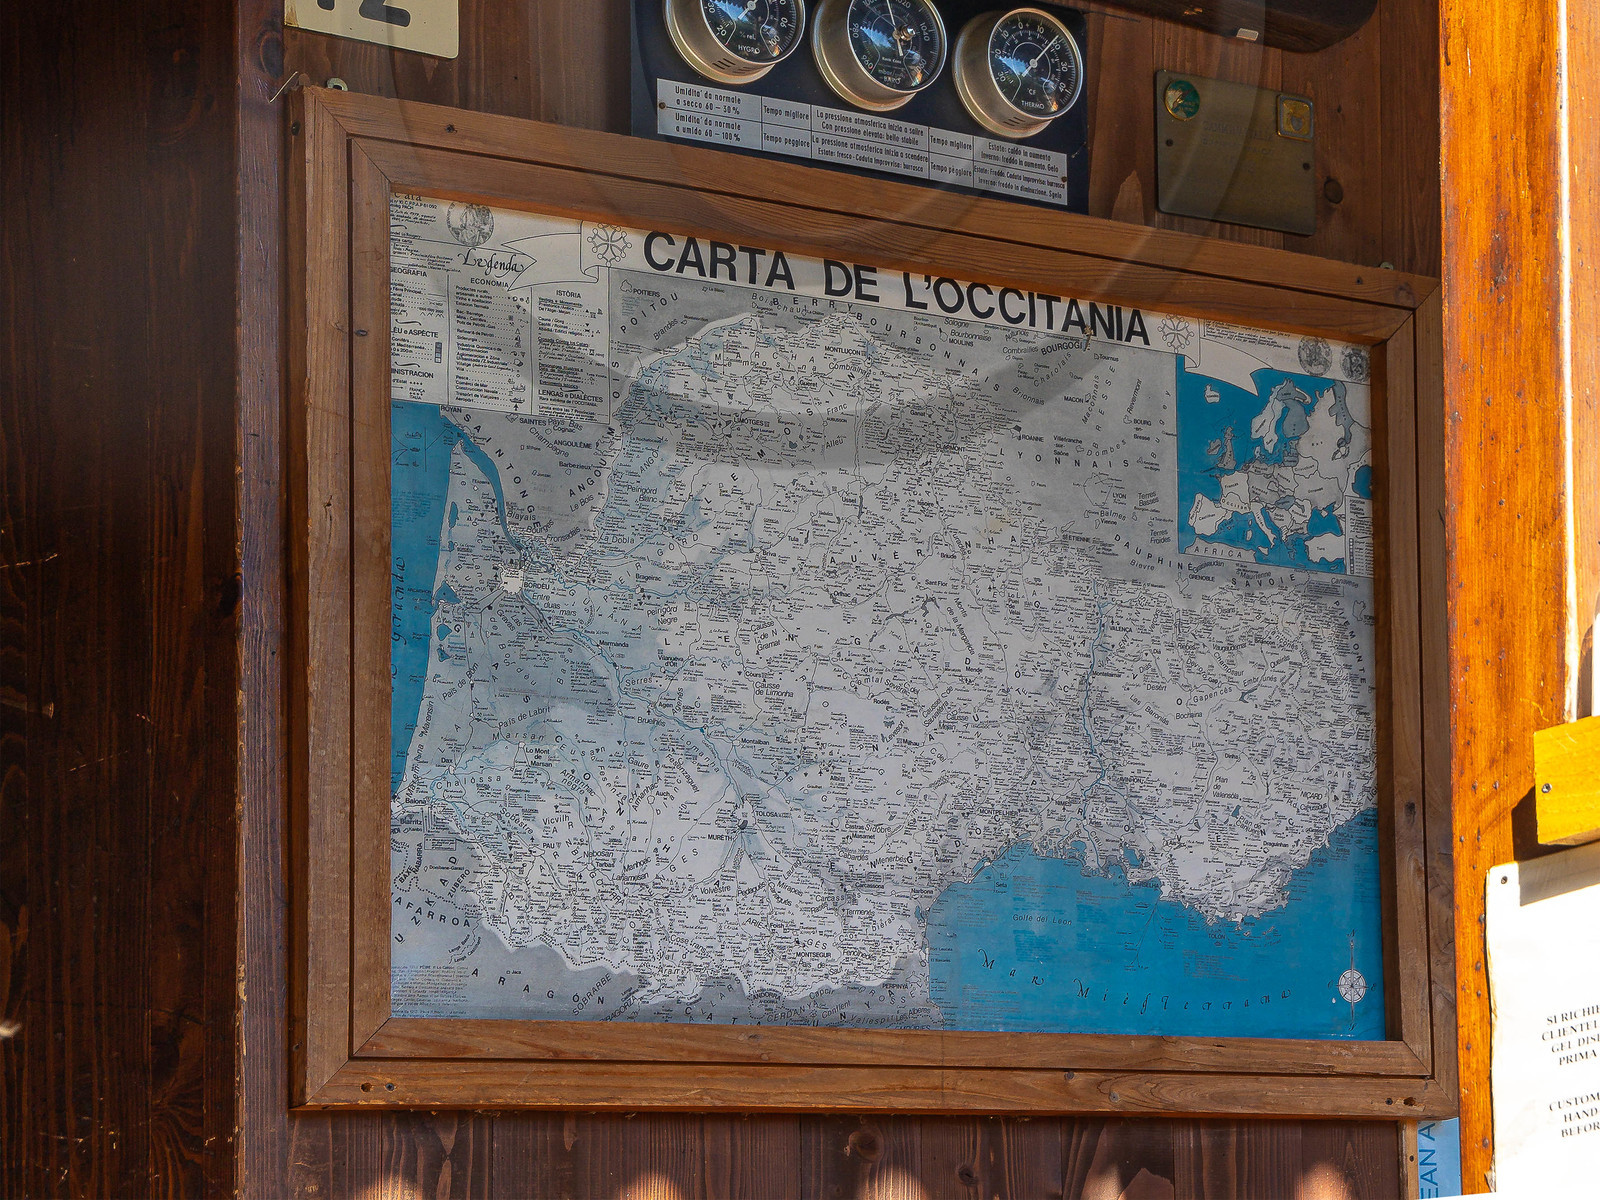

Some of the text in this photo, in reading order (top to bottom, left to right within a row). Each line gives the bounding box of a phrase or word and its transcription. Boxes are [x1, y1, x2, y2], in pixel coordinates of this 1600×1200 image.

[708, 3, 715, 13] 30
[780, 17, 788, 28] 90
[717, 26, 726, 36] 20
[920, 23, 929, 41] 1040
[1001, 31, 1009, 39] 10
[1037, 26, 1044, 34] 10
[769, 35, 780, 46] 100
[738, 44, 760, 54] HYGRO
[861, 55, 873, 69] 960
[1061, 61, 1068, 72] 30
[998, 72, 1005, 82] 30
[705, 91, 712, 99] da
[715, 94, 741, 104] normale
[683, 100, 702, 109] secco
[705, 102, 713, 110] 60
[1022, 101, 1044, 109] THERMO
[764, 106, 809, 120] Tempo migliore
[715, 120, 741, 130] normale
[817, 110, 824, 118] La
[825, 112, 852, 123] pressione
[855, 117, 886, 129] atmosferica
[888, 122, 902, 131] inizia
[909, 128, 924, 136] salire
[683, 126, 702, 135] umido
[705, 129, 712, 137] 60
[822, 122, 918, 146] Con pressione elevata: bello stabile
[764, 133, 810, 148] Tempo peggiore
[930, 135, 972, 150] Tempo migliore
[812, 135, 819, 143] La
[822, 137, 848, 148] pressione
[850, 141, 882, 154] atmosferica
[885, 148, 899, 156] inizia
[905, 152, 928, 162] scendere
[988, 142, 1006, 152] Estate:
[1008, 146, 1021, 155] caldo
[1029, 152, 1051, 161] aumento
[818, 148, 836, 156] Estate:
[874, 157, 902, 169] improvvisa:
[903, 163, 924, 172] burrasca
[981, 151, 1000, 161] Inverno:
[1002, 155, 1018, 164] freddo
[1047, 164, 1058, 172] Gelo
[931, 162, 972, 176] Tempo peggiore
[974, 165, 989, 174] Estate:
[978, 177, 997, 186] Inverno:
[998, 180, 1013, 189] freddo
[1049, 190, 1062, 199] Sgelo
[470, 278, 509, 288] ECONOMIA
[643, 230, 795, 290] CARTA
[823, 259, 879, 303] DE
[903, 271, 1150, 345] L'OCCITANIA
[633, 289, 660, 297] POITIERS
[949, 338, 973, 347] MOULINS
[538, 389, 564, 398] LENGAS
[520, 418, 546, 426] SAINTES
[507, 511, 536, 520] Blayais
[1100, 510, 1126, 520] Balmes
[1194, 547, 1242, 558] AFRICA
[1013, 914, 1032, 922] Golfe
[1547, 1015, 1557, 1025] SI
[1559, 1049, 1597, 1065] PRIMA
[1564, 1107, 1598, 1122] HAND
